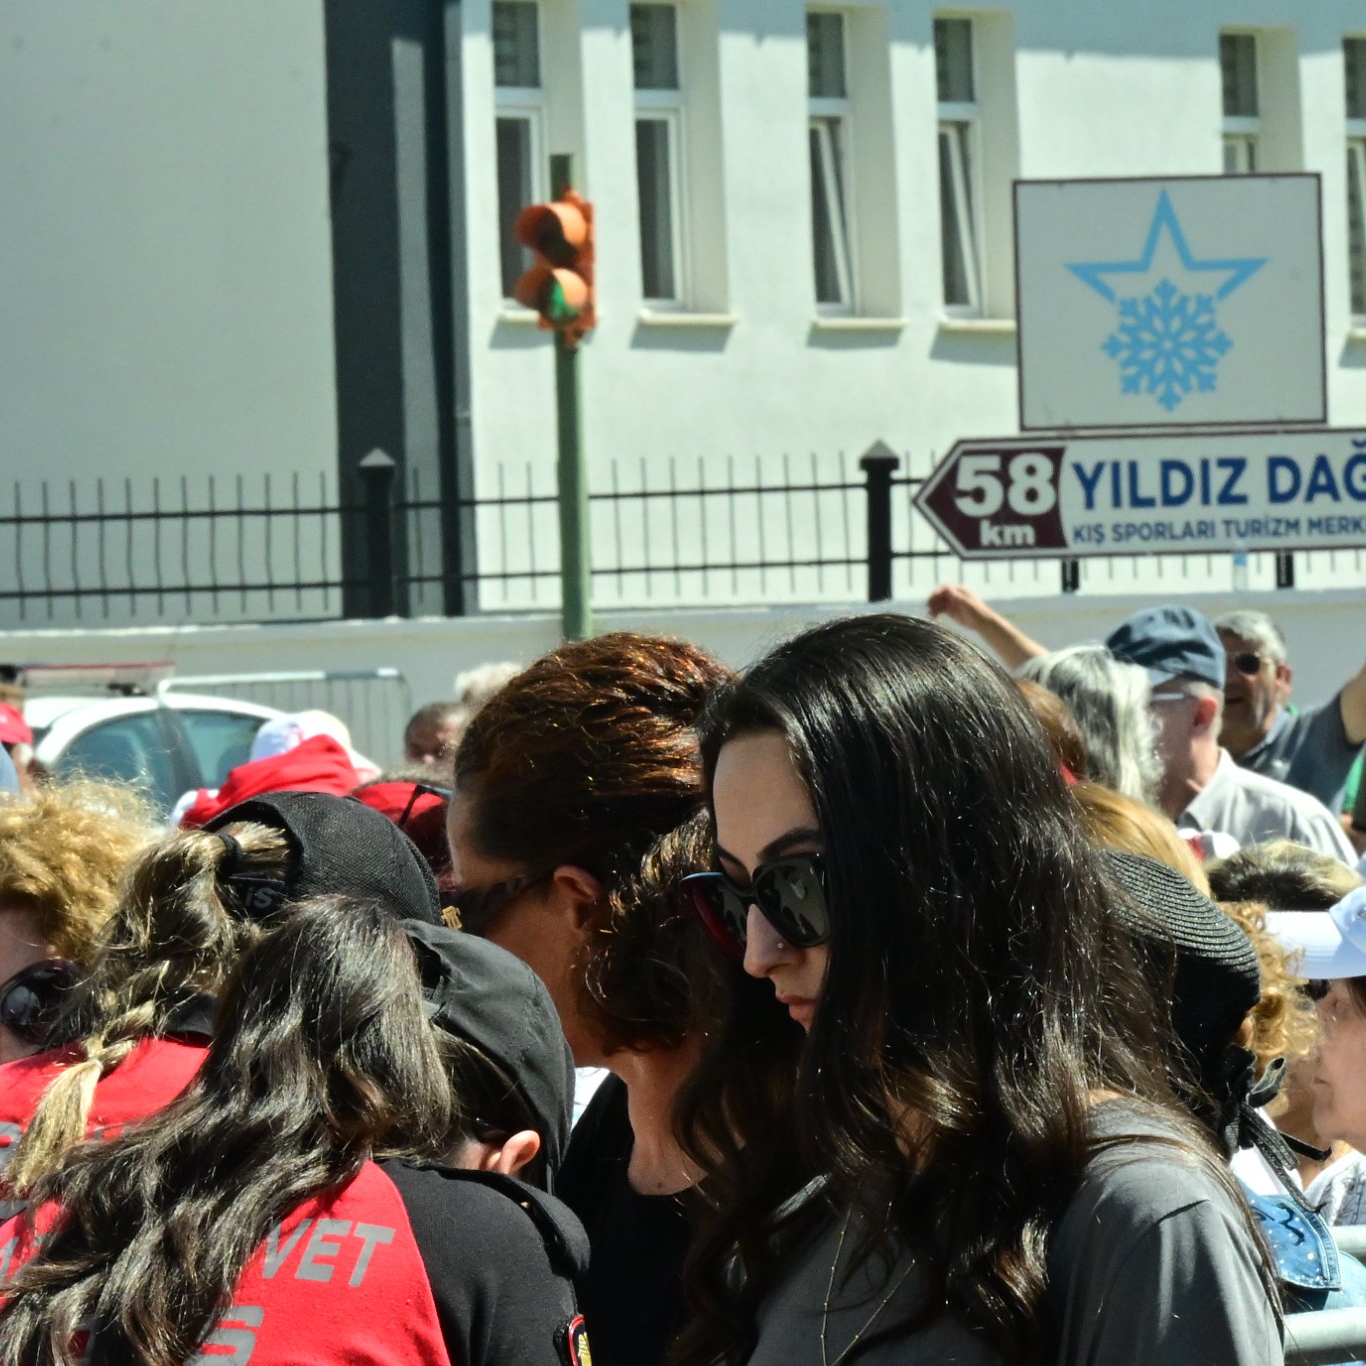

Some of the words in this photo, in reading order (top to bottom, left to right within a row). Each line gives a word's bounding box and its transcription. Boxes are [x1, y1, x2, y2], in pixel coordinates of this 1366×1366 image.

[954, 452, 1056, 518] 58
[1071, 458, 1248, 511] YILDIZ
[979, 520, 1035, 547] km
[1072, 524, 1106, 544] KIŞ
[1111, 519, 1215, 542] SPORLARI
[1222, 515, 1301, 538] TURİZM
